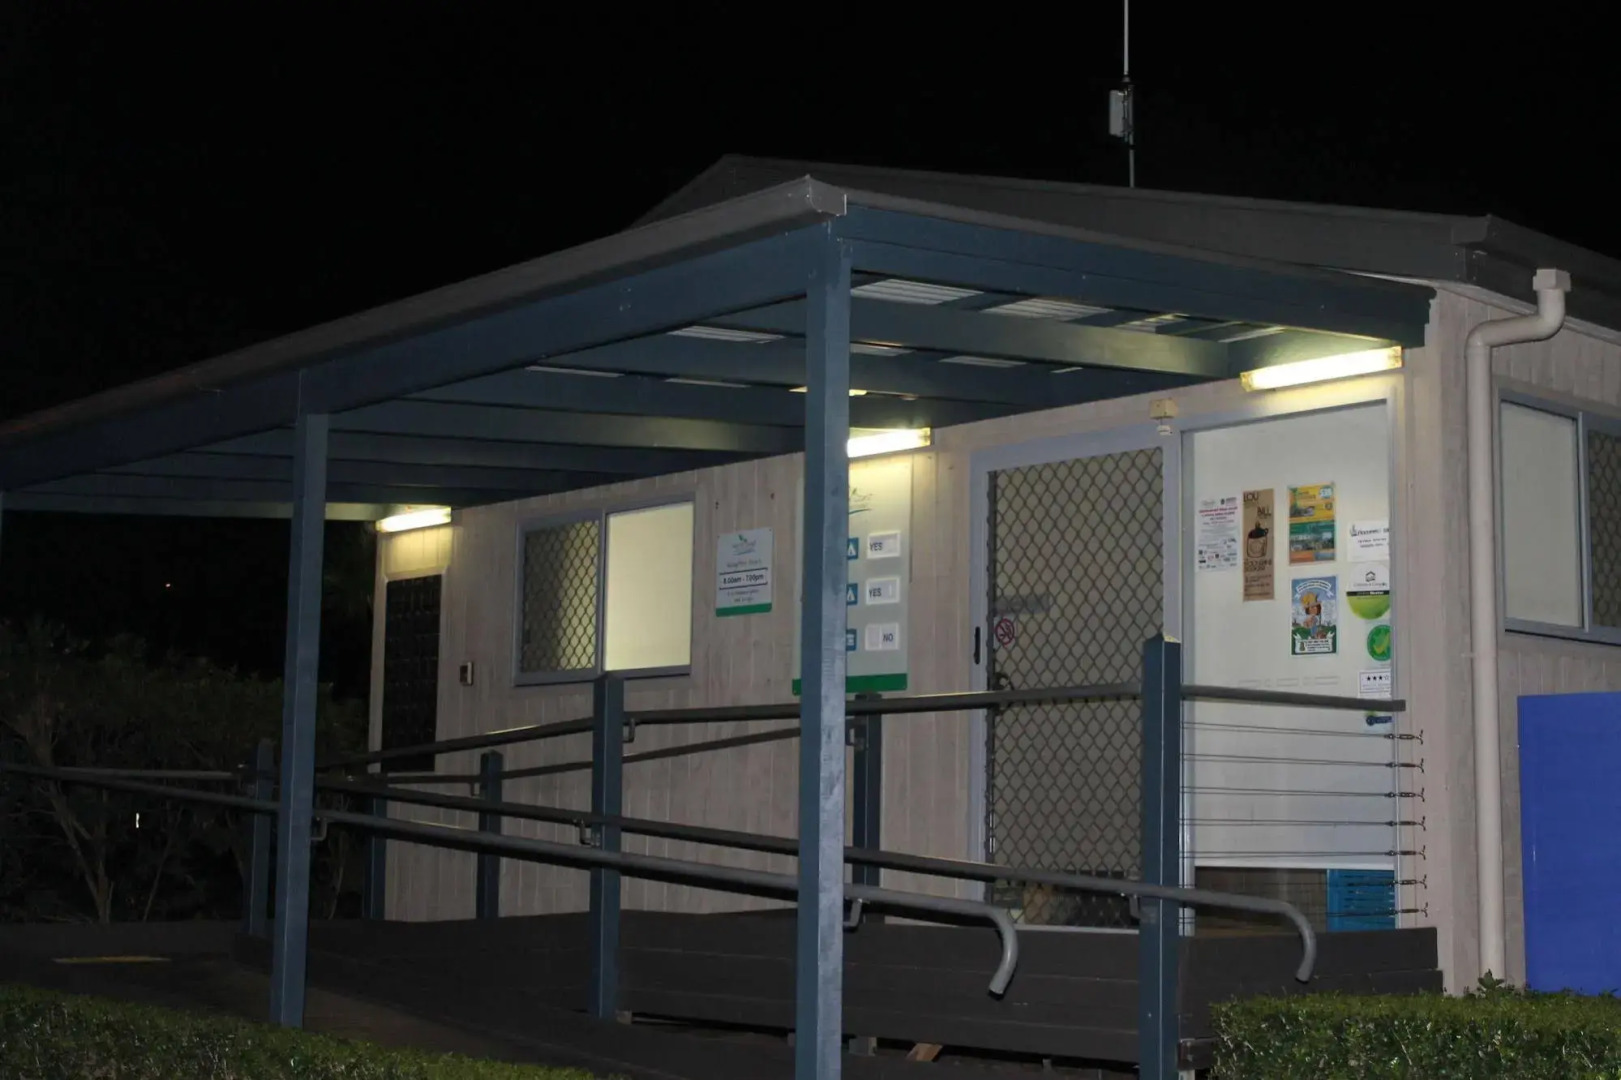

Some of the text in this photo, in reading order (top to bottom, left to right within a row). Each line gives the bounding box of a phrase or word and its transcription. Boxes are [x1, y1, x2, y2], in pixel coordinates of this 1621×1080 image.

[869, 542, 883, 551] YES
[868, 588, 882, 597] YES
[883, 634, 894, 642] NO
